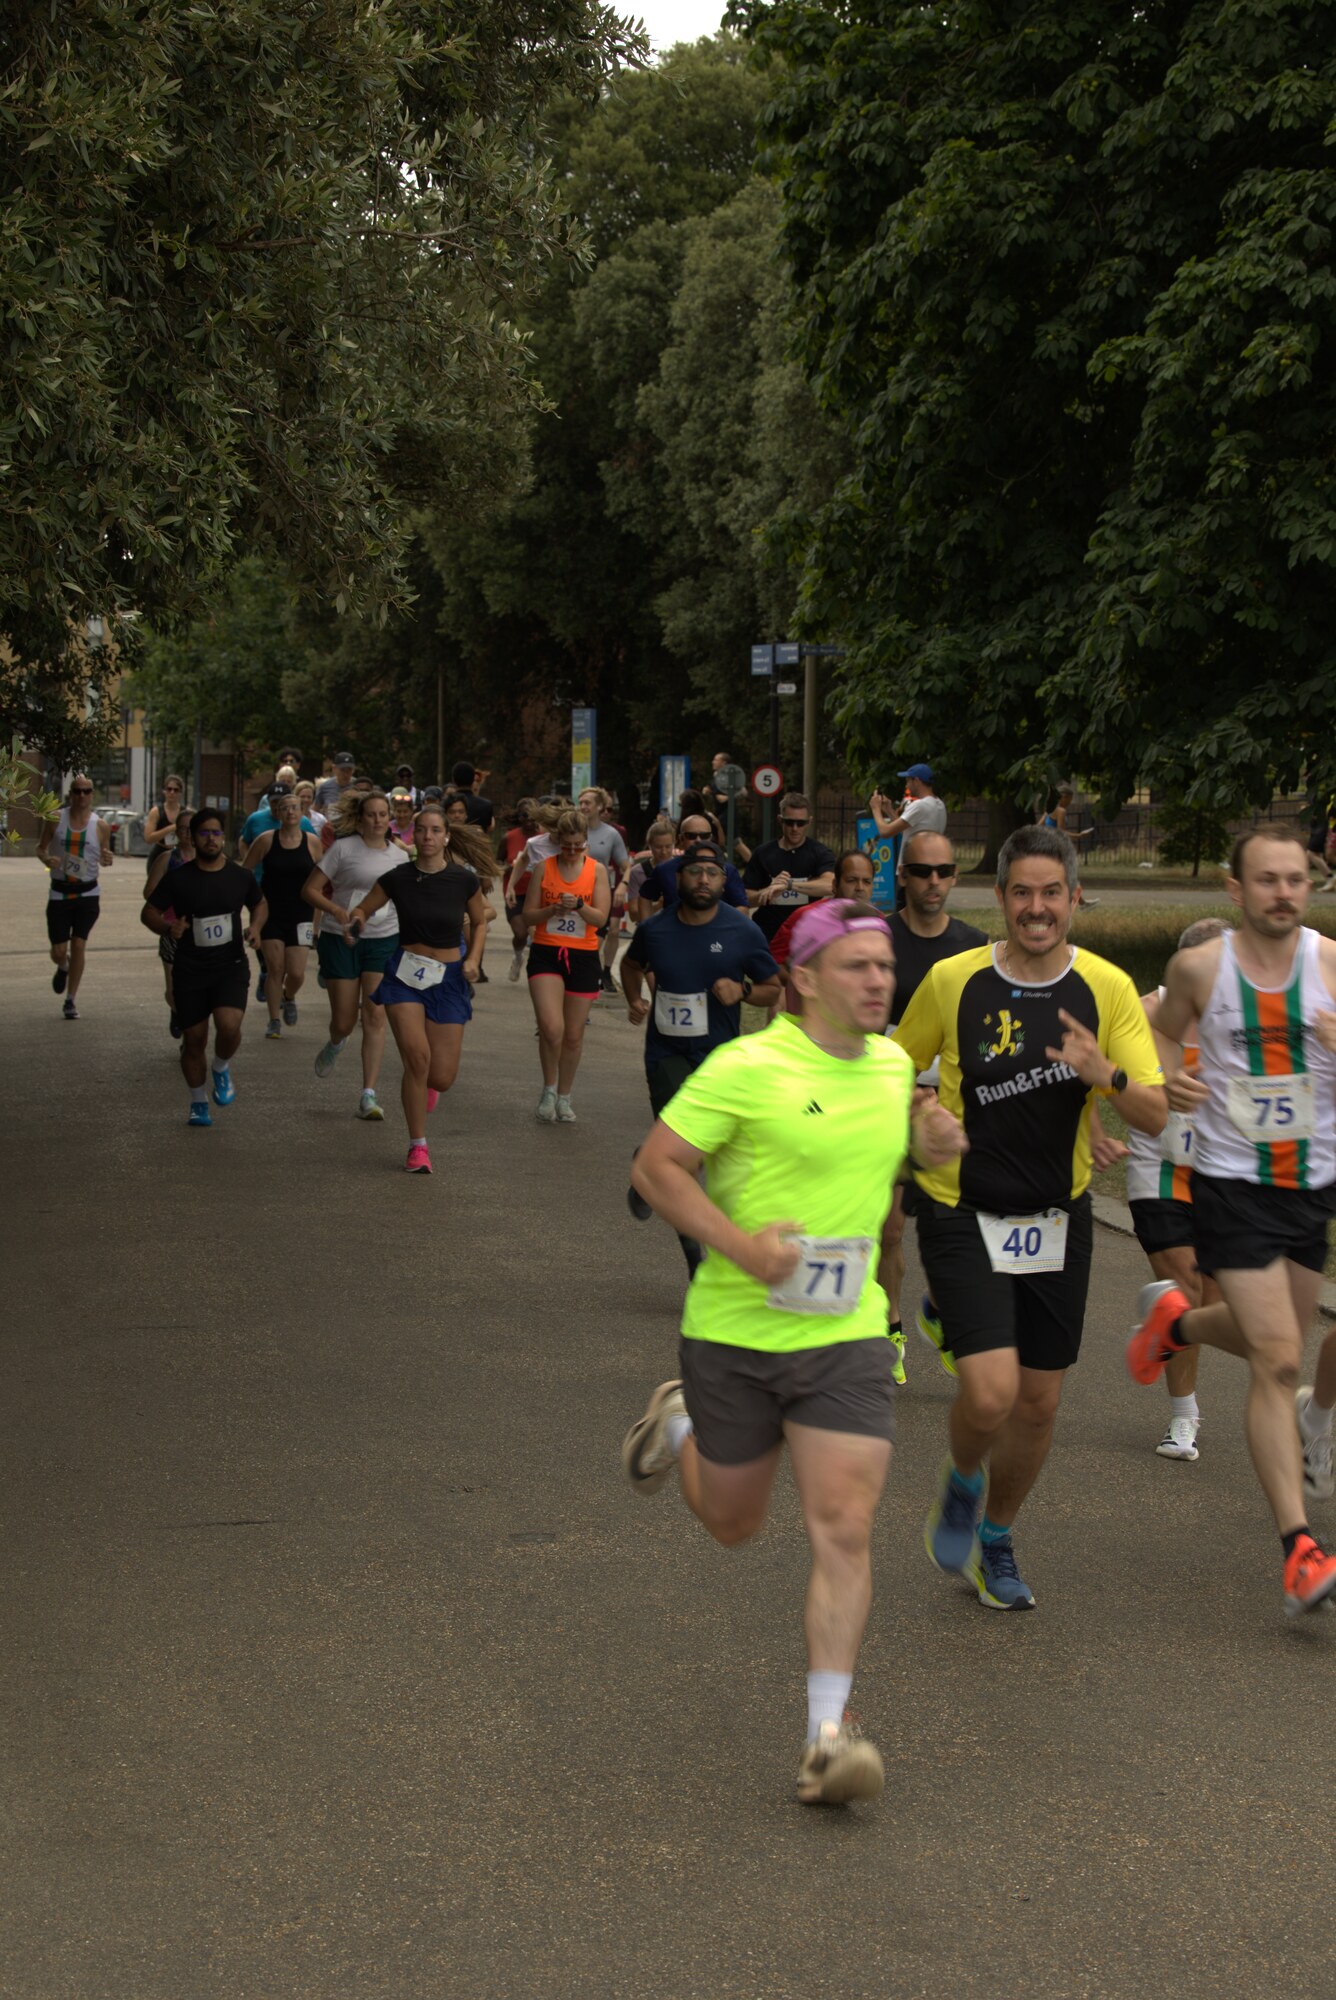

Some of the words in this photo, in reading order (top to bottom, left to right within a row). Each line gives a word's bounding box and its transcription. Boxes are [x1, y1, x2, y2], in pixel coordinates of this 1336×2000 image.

[763, 775, 772, 787] 5
[67, 861, 81, 873] 79
[204, 925, 223, 939] 10
[557, 919, 576, 932] 28
[414, 967, 426, 981] 4
[668, 1007, 693, 1025] 12
[1252, 1096, 1295, 1126] 75
[1002, 1227, 1042, 1257] 40
[806, 1261, 847, 1297] 71
